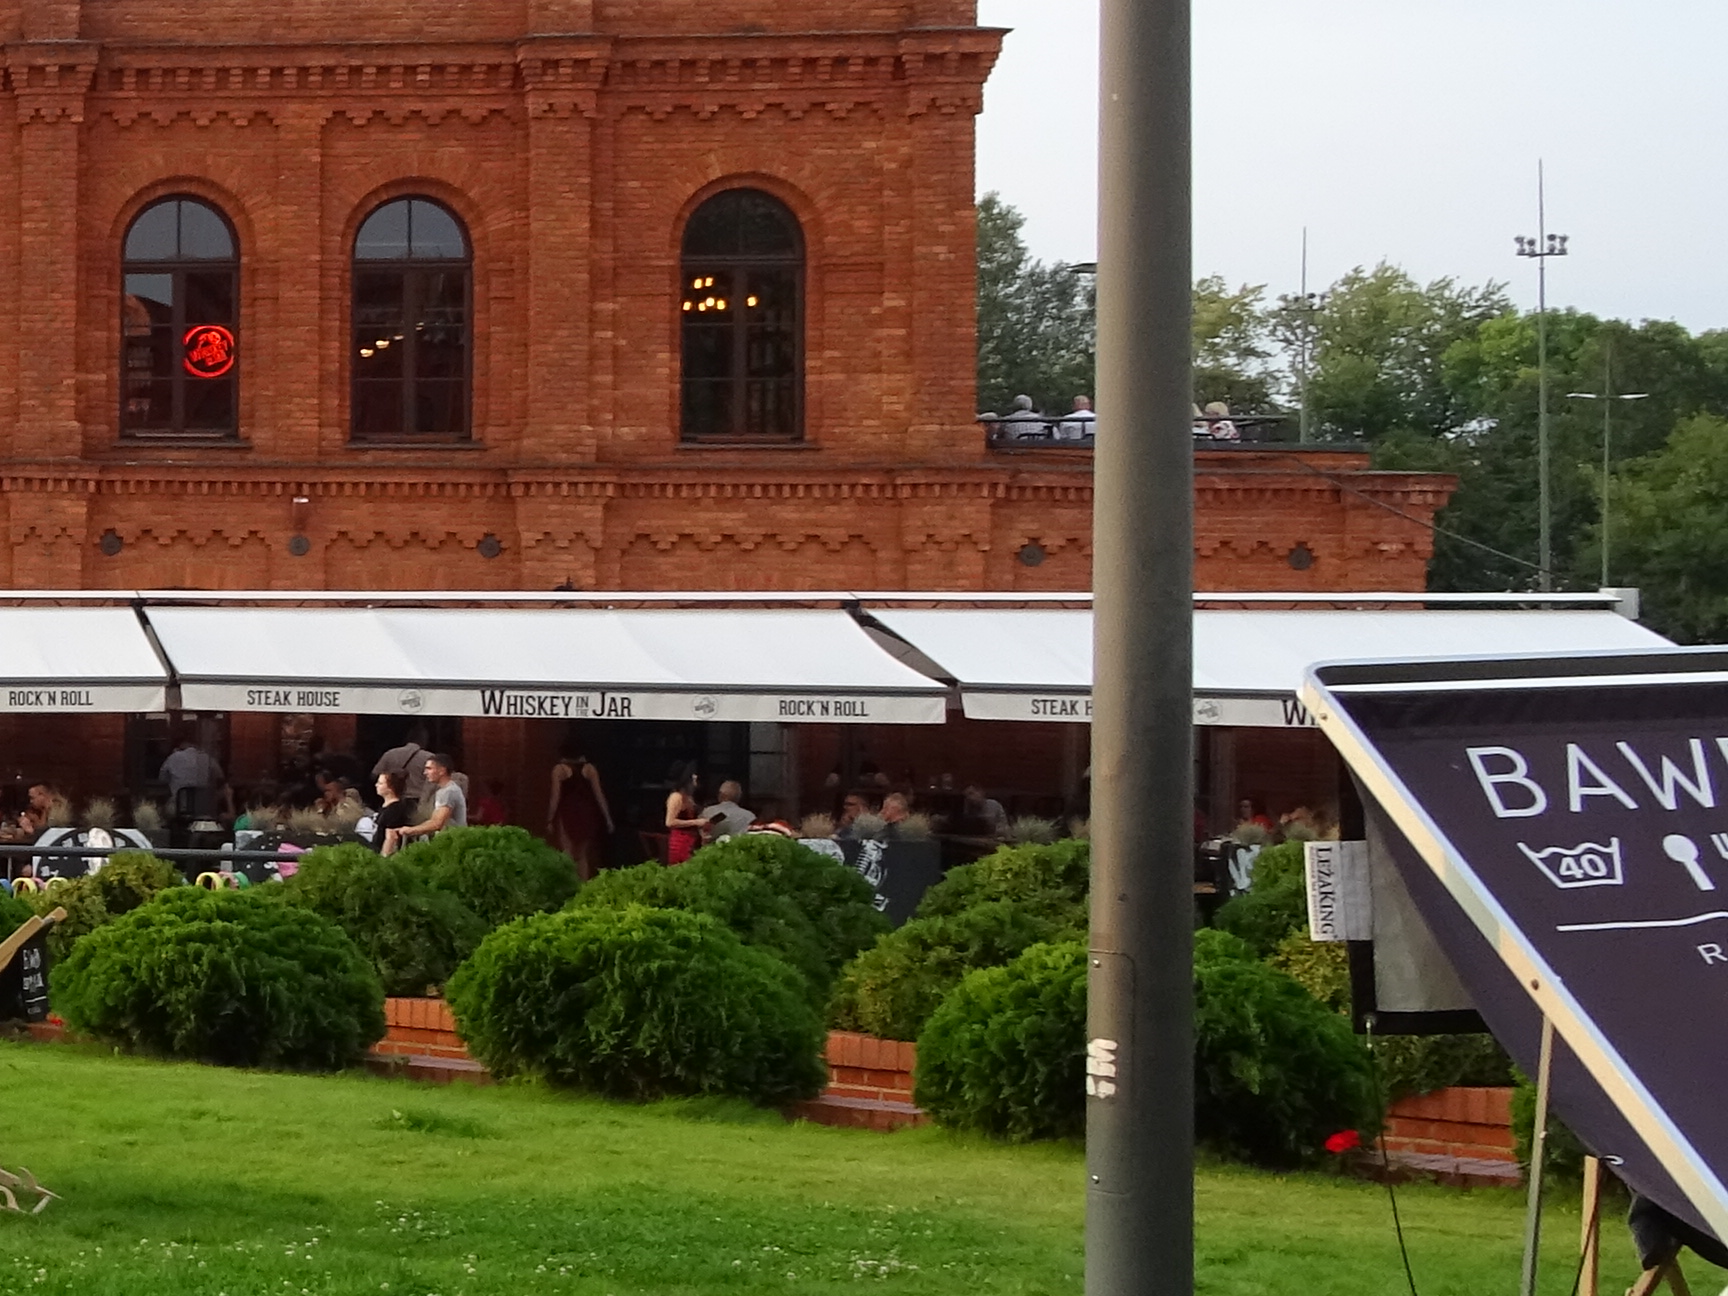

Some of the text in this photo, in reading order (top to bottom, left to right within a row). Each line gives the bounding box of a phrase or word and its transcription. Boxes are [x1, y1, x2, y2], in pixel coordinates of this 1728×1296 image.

[60, 690, 94, 706] ROLL
[247, 690, 341, 707] STEAK HOUSE
[480, 690, 573, 716] WHISKEY
[576, 696, 589, 708] IN
[592, 691, 632, 717] JAR
[834, 701, 870, 717] ROLL
[1031, 699, 1079, 716] STEAK
[1466, 737, 1728, 818] BAW
[1559, 855, 1608, 879] 40
